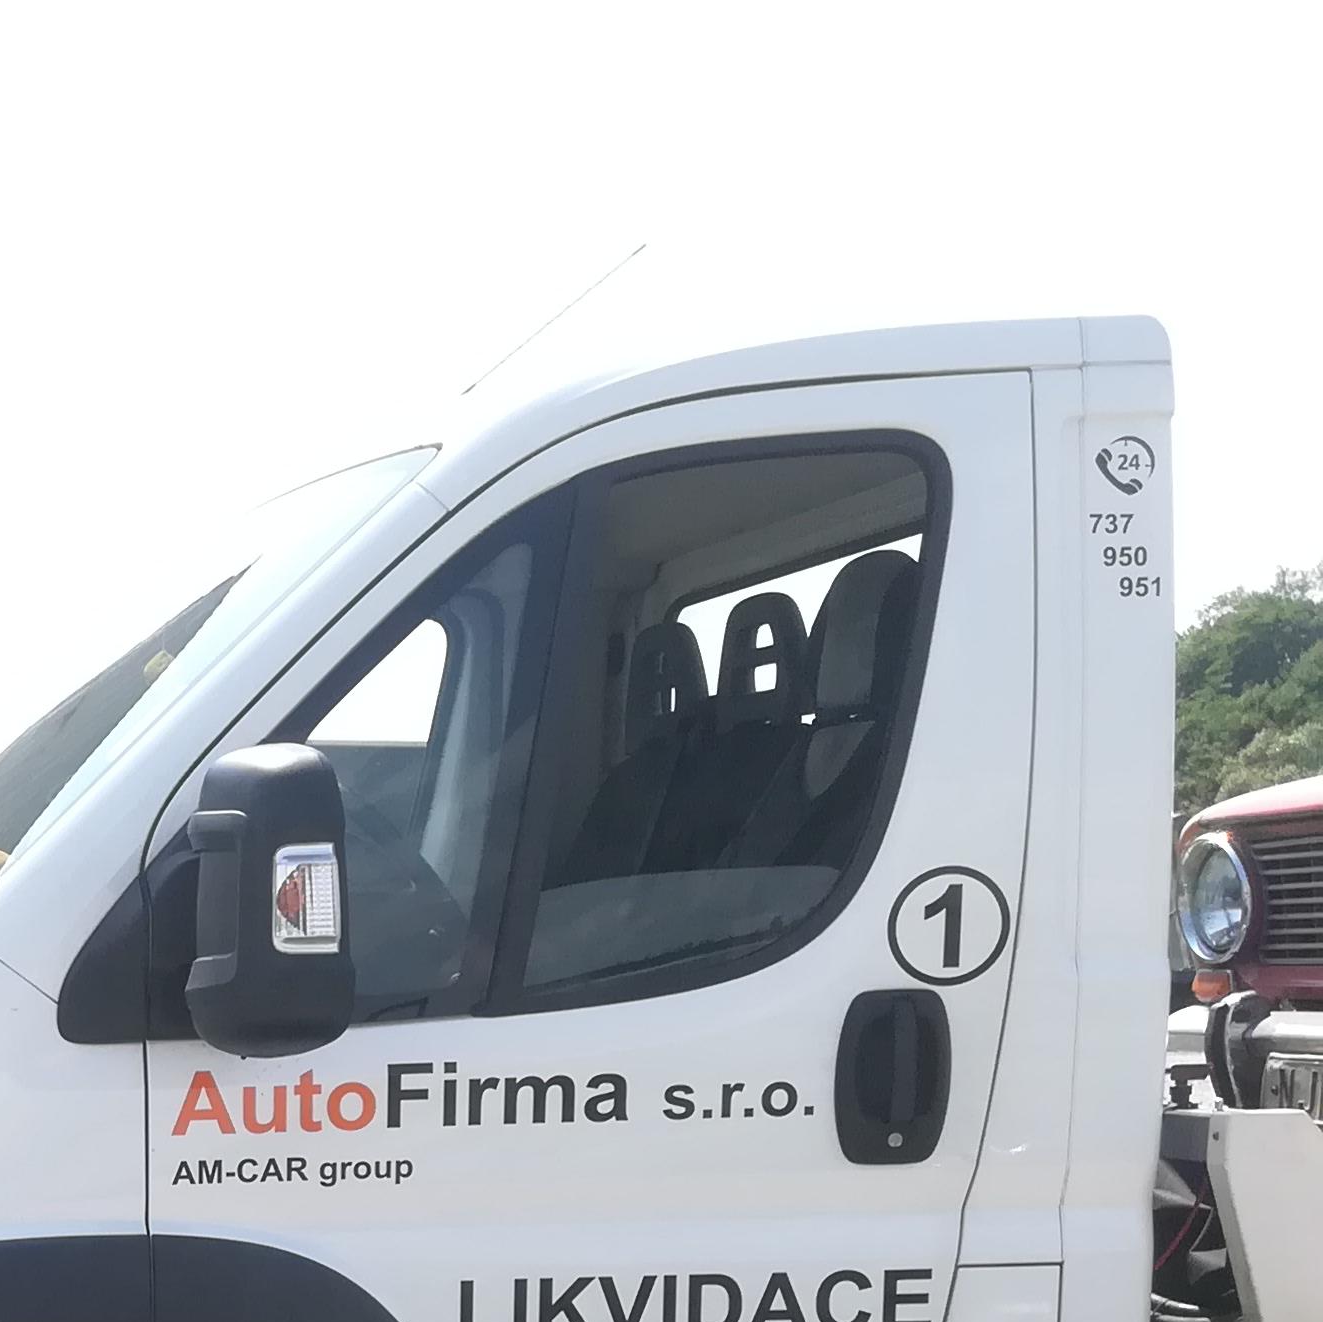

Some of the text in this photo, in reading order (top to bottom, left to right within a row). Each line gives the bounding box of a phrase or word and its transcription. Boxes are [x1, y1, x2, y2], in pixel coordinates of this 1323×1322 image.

[1117, 453, 1141, 471] 24
[1089, 513, 1134, 534] 737
[1102, 546, 1148, 567] 950
[1119, 576, 1161, 597] 951
[923, 883, 963, 968] 1
[171, 1061, 816, 1137] AutoFirma s.r.o.
[171, 1156, 414, 1188] AM-CAR group
